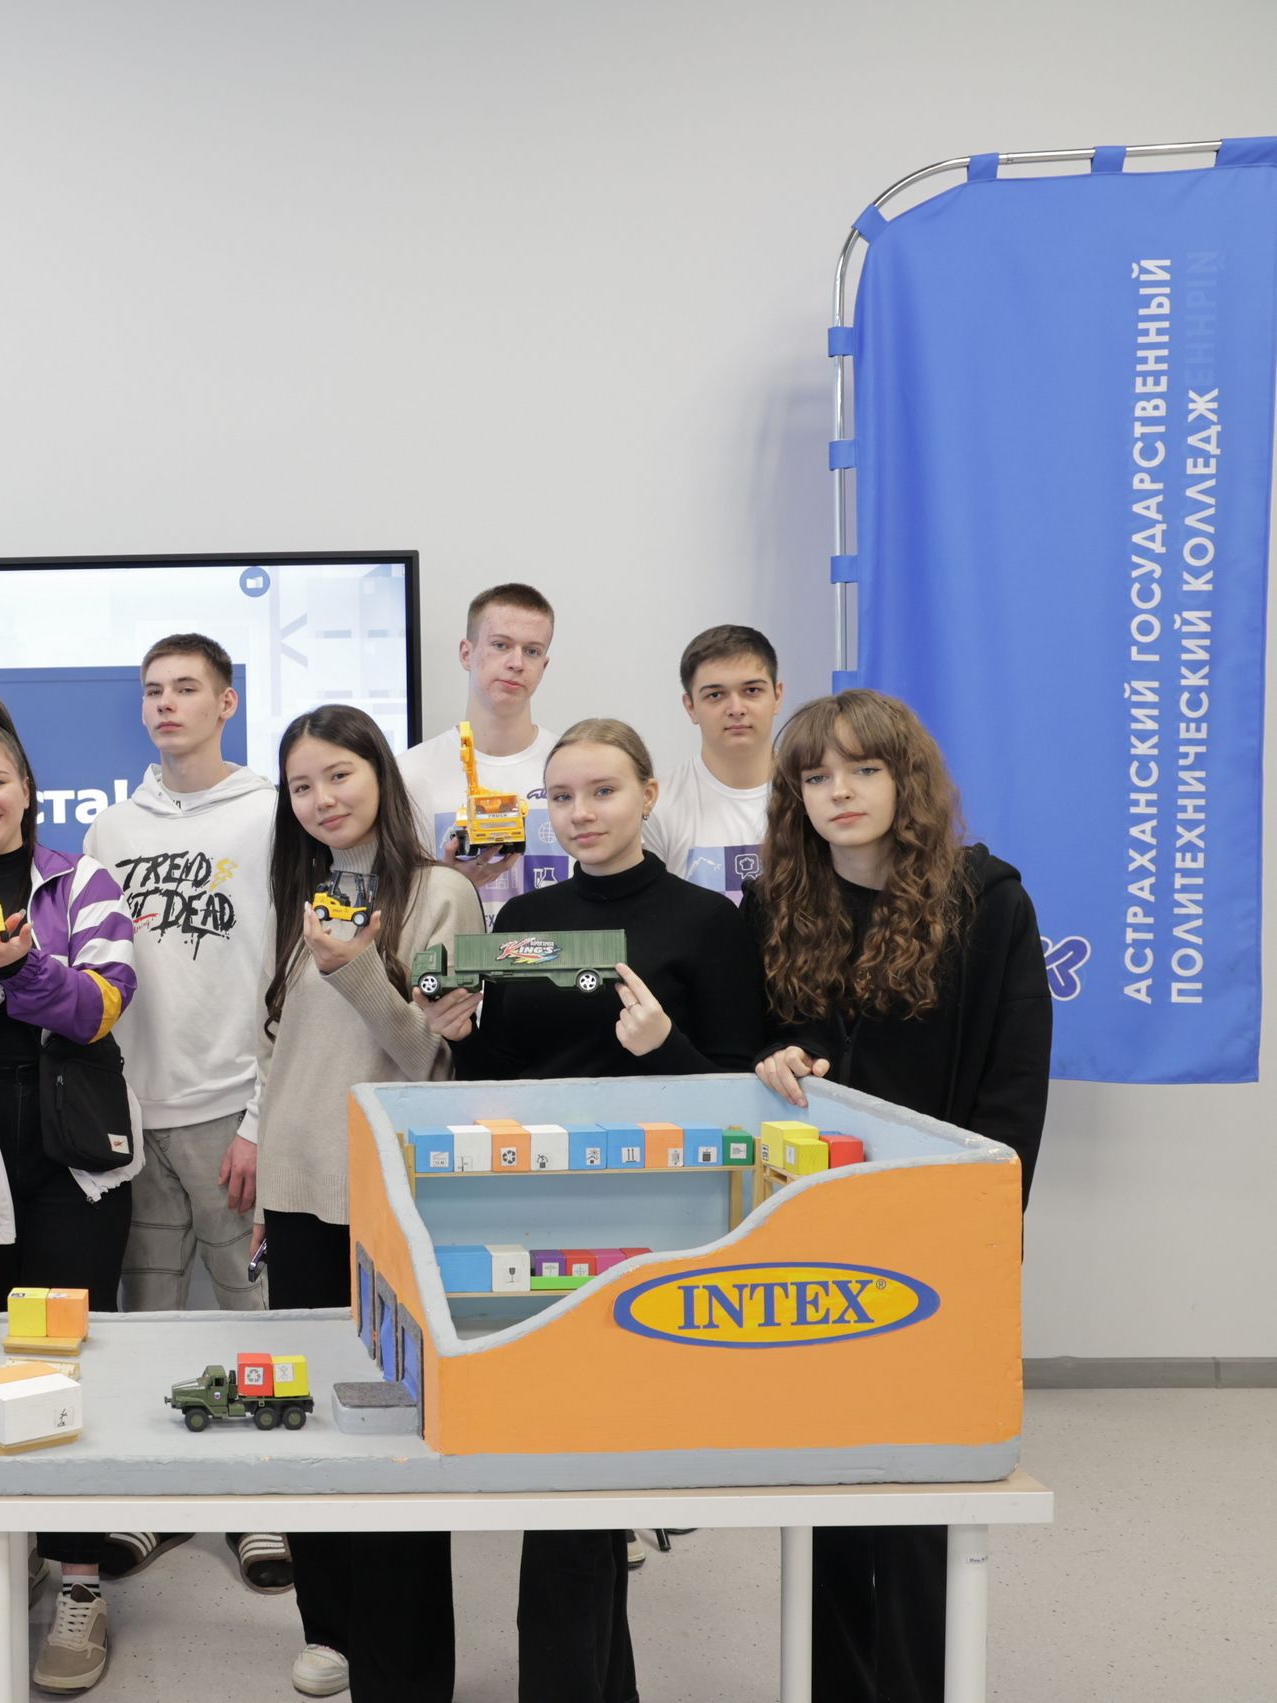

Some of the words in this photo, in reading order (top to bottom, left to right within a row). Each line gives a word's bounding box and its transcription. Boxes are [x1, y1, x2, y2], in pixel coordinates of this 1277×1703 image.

[1129, 258, 1172, 662] ГОСУДАРСТВЕННЫЙ
[1181, 388, 1222, 591] КОЛЛЕДЖ
[115, 850, 212, 892] TREND
[150, 890, 236, 940] DEAD
[1123, 680, 1161, 1005] АСТРАХАНСКИЙ
[1170, 610, 1212, 1004] ПОЛИТЕХНИЧЕСКИЙ
